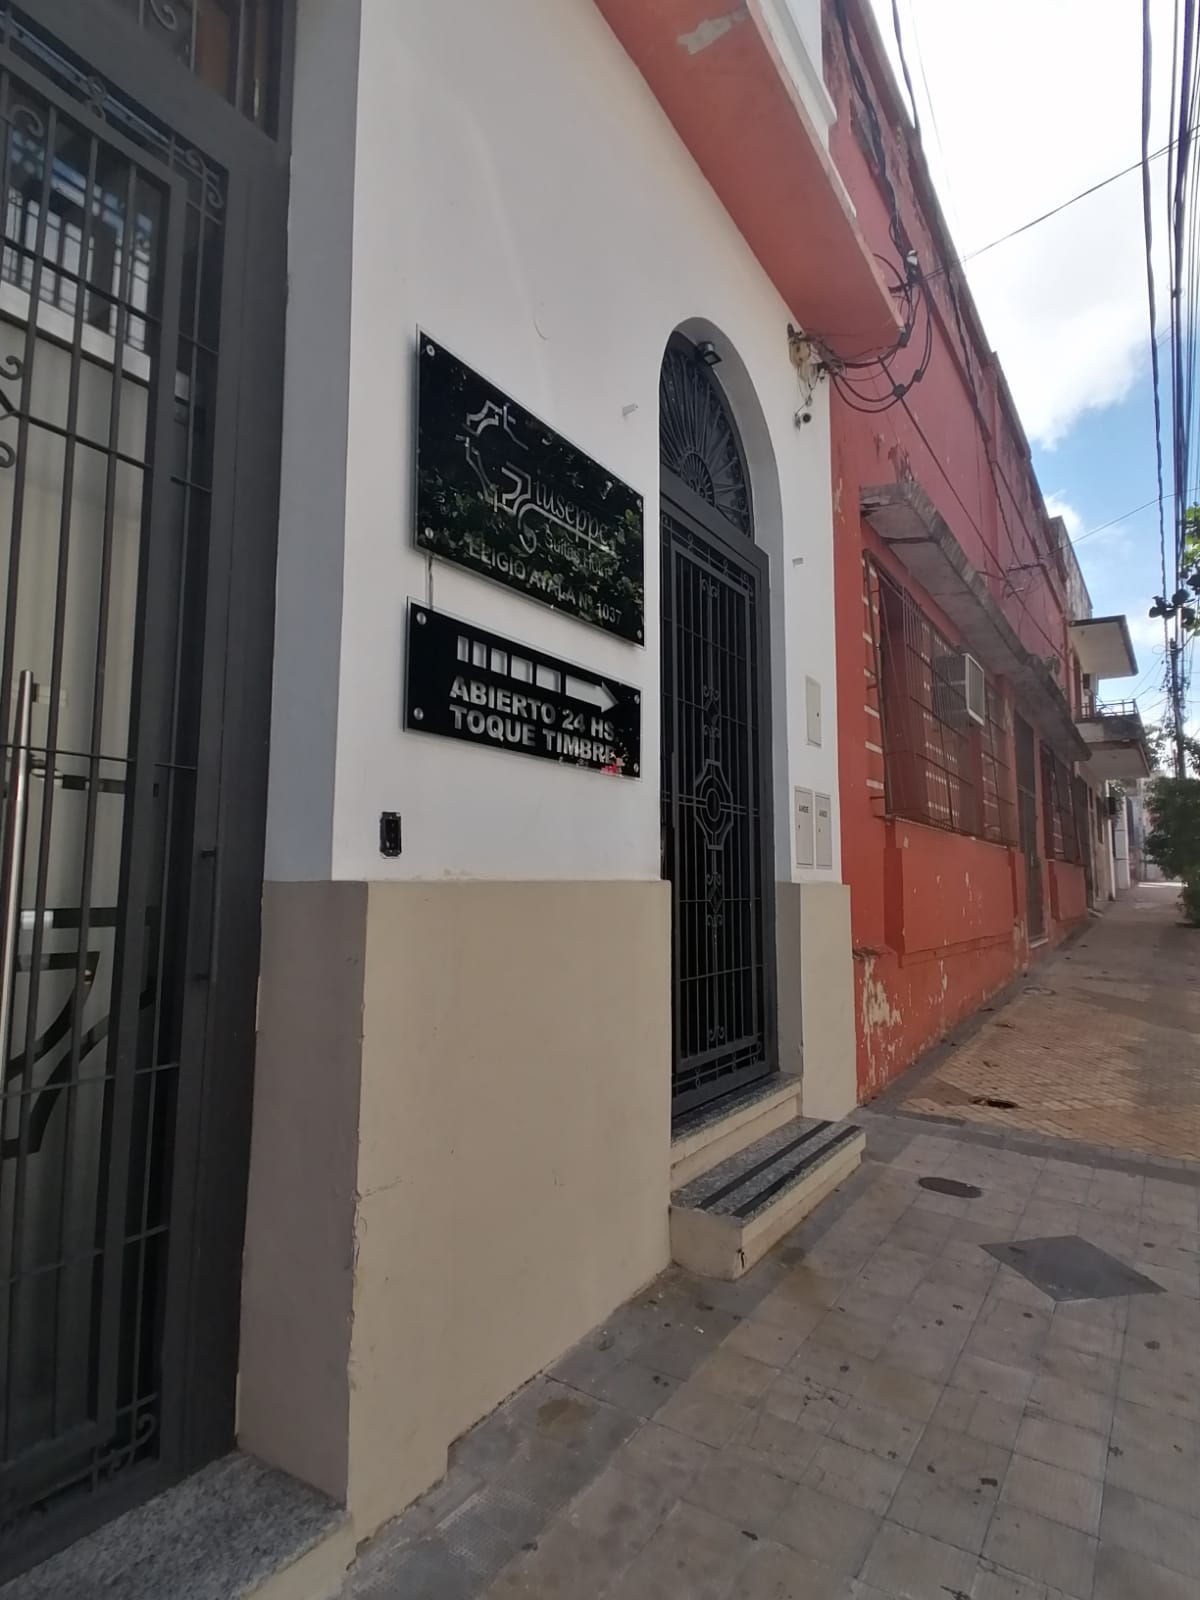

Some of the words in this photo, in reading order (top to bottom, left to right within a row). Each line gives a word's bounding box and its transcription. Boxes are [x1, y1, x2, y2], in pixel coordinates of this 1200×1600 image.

[468, 539, 526, 580] ELIGIO
[529, 569, 576, 606] AYALA
[597, 601, 623, 624] 1037
[449, 675, 556, 725] ABIERTO
[562, 709, 586, 733] 24
[449, 704, 536, 747] TOQUE
[542, 727, 616, 765] TIMBRE
